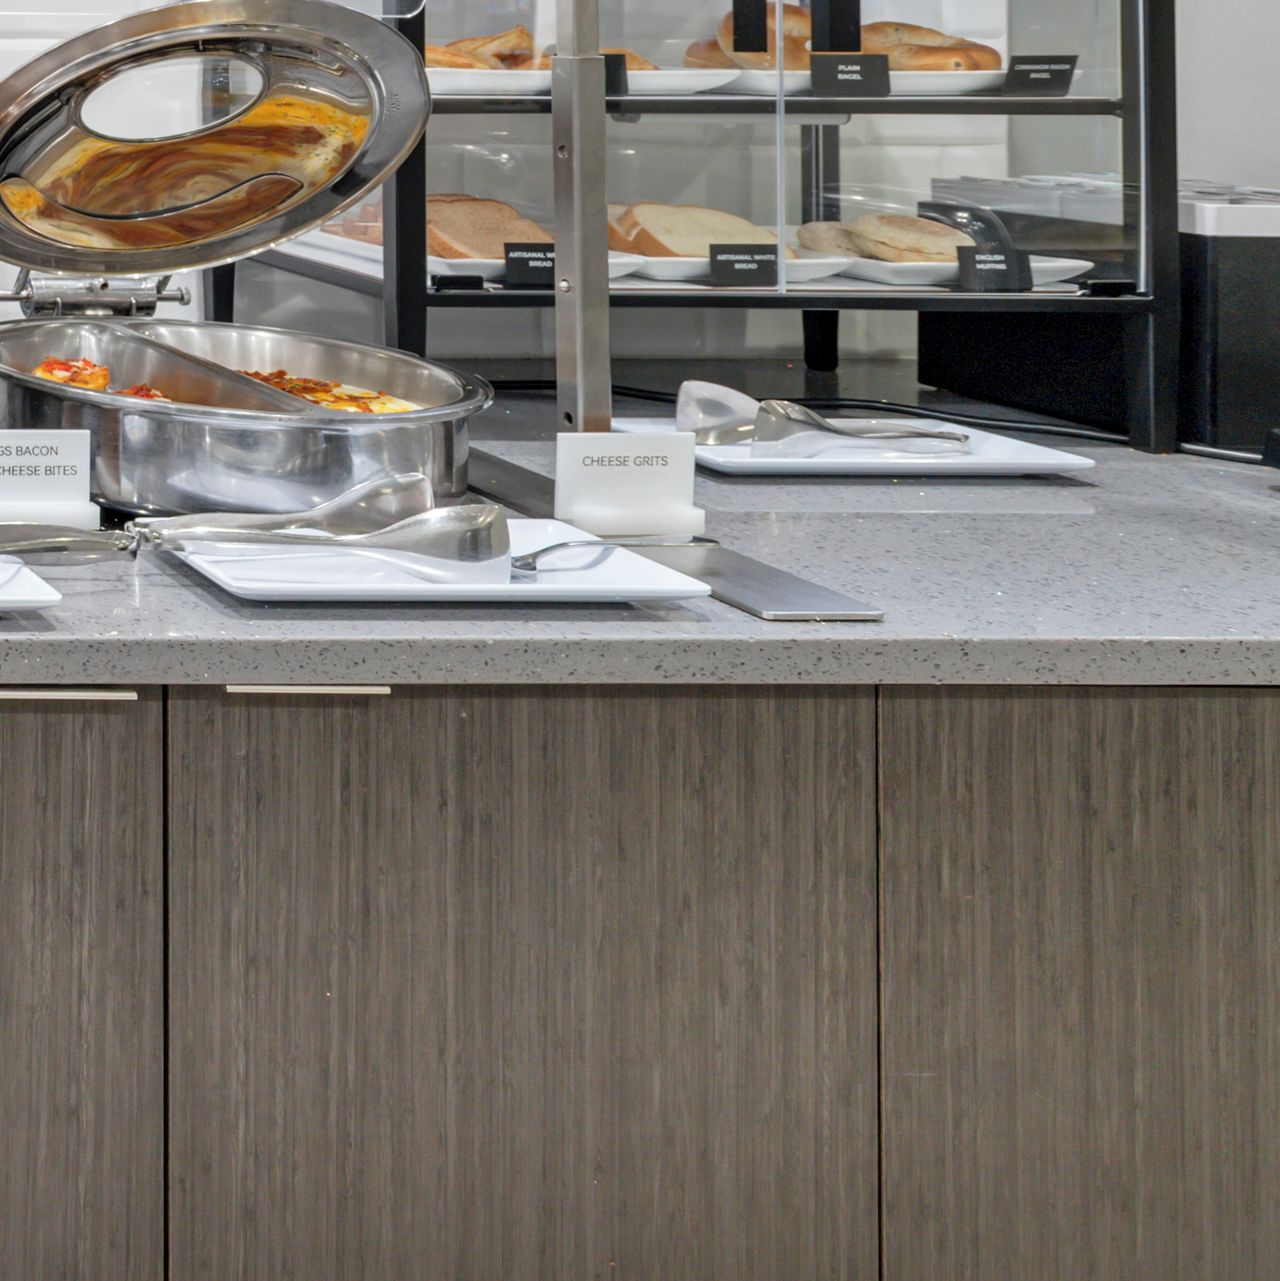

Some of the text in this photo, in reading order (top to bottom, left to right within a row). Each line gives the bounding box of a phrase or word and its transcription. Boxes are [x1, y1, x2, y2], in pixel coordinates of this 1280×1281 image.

[16, 446, 58, 456] BACON
[583, 456, 668, 466] CHEESE GRITS
[45, 465, 77, 476] BITES
